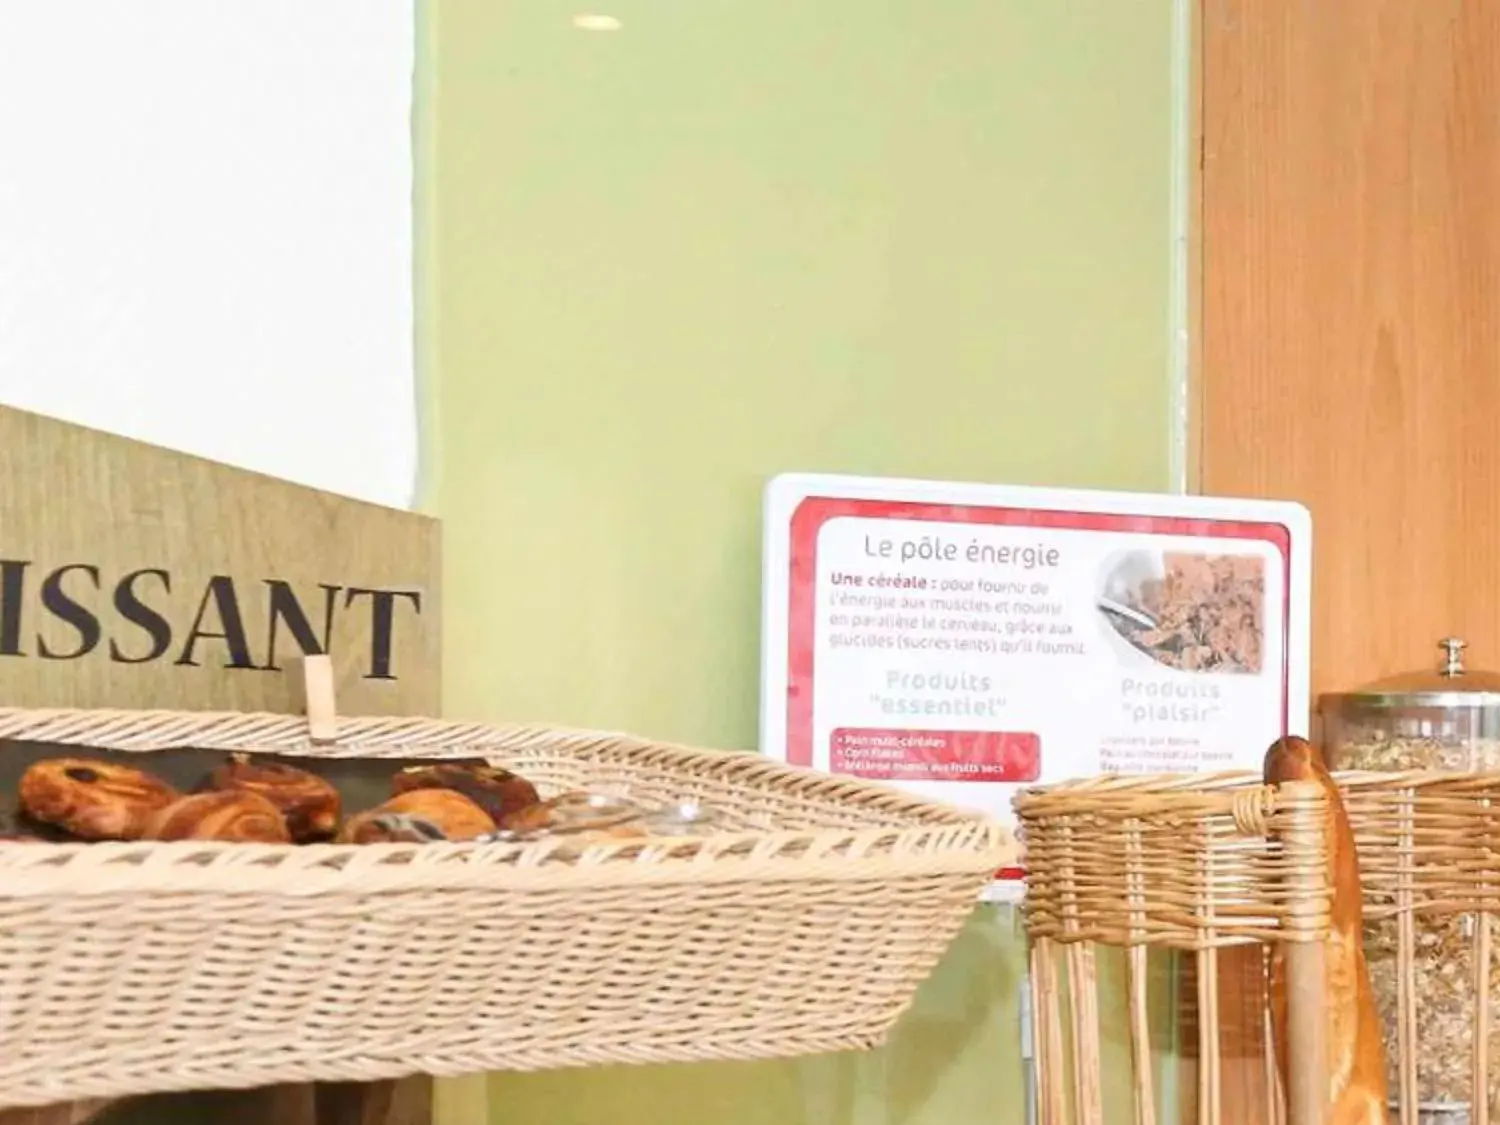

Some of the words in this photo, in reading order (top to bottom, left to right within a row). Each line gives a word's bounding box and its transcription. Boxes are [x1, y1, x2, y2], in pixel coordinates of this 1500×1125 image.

[865, 534, 893, 557] Le
[900, 536, 958, 563] pôle
[966, 538, 1061, 569] énergie
[830, 572, 863, 587] Une
[885, 669, 992, 692] Produits
[1122, 677, 1221, 698] Produits
